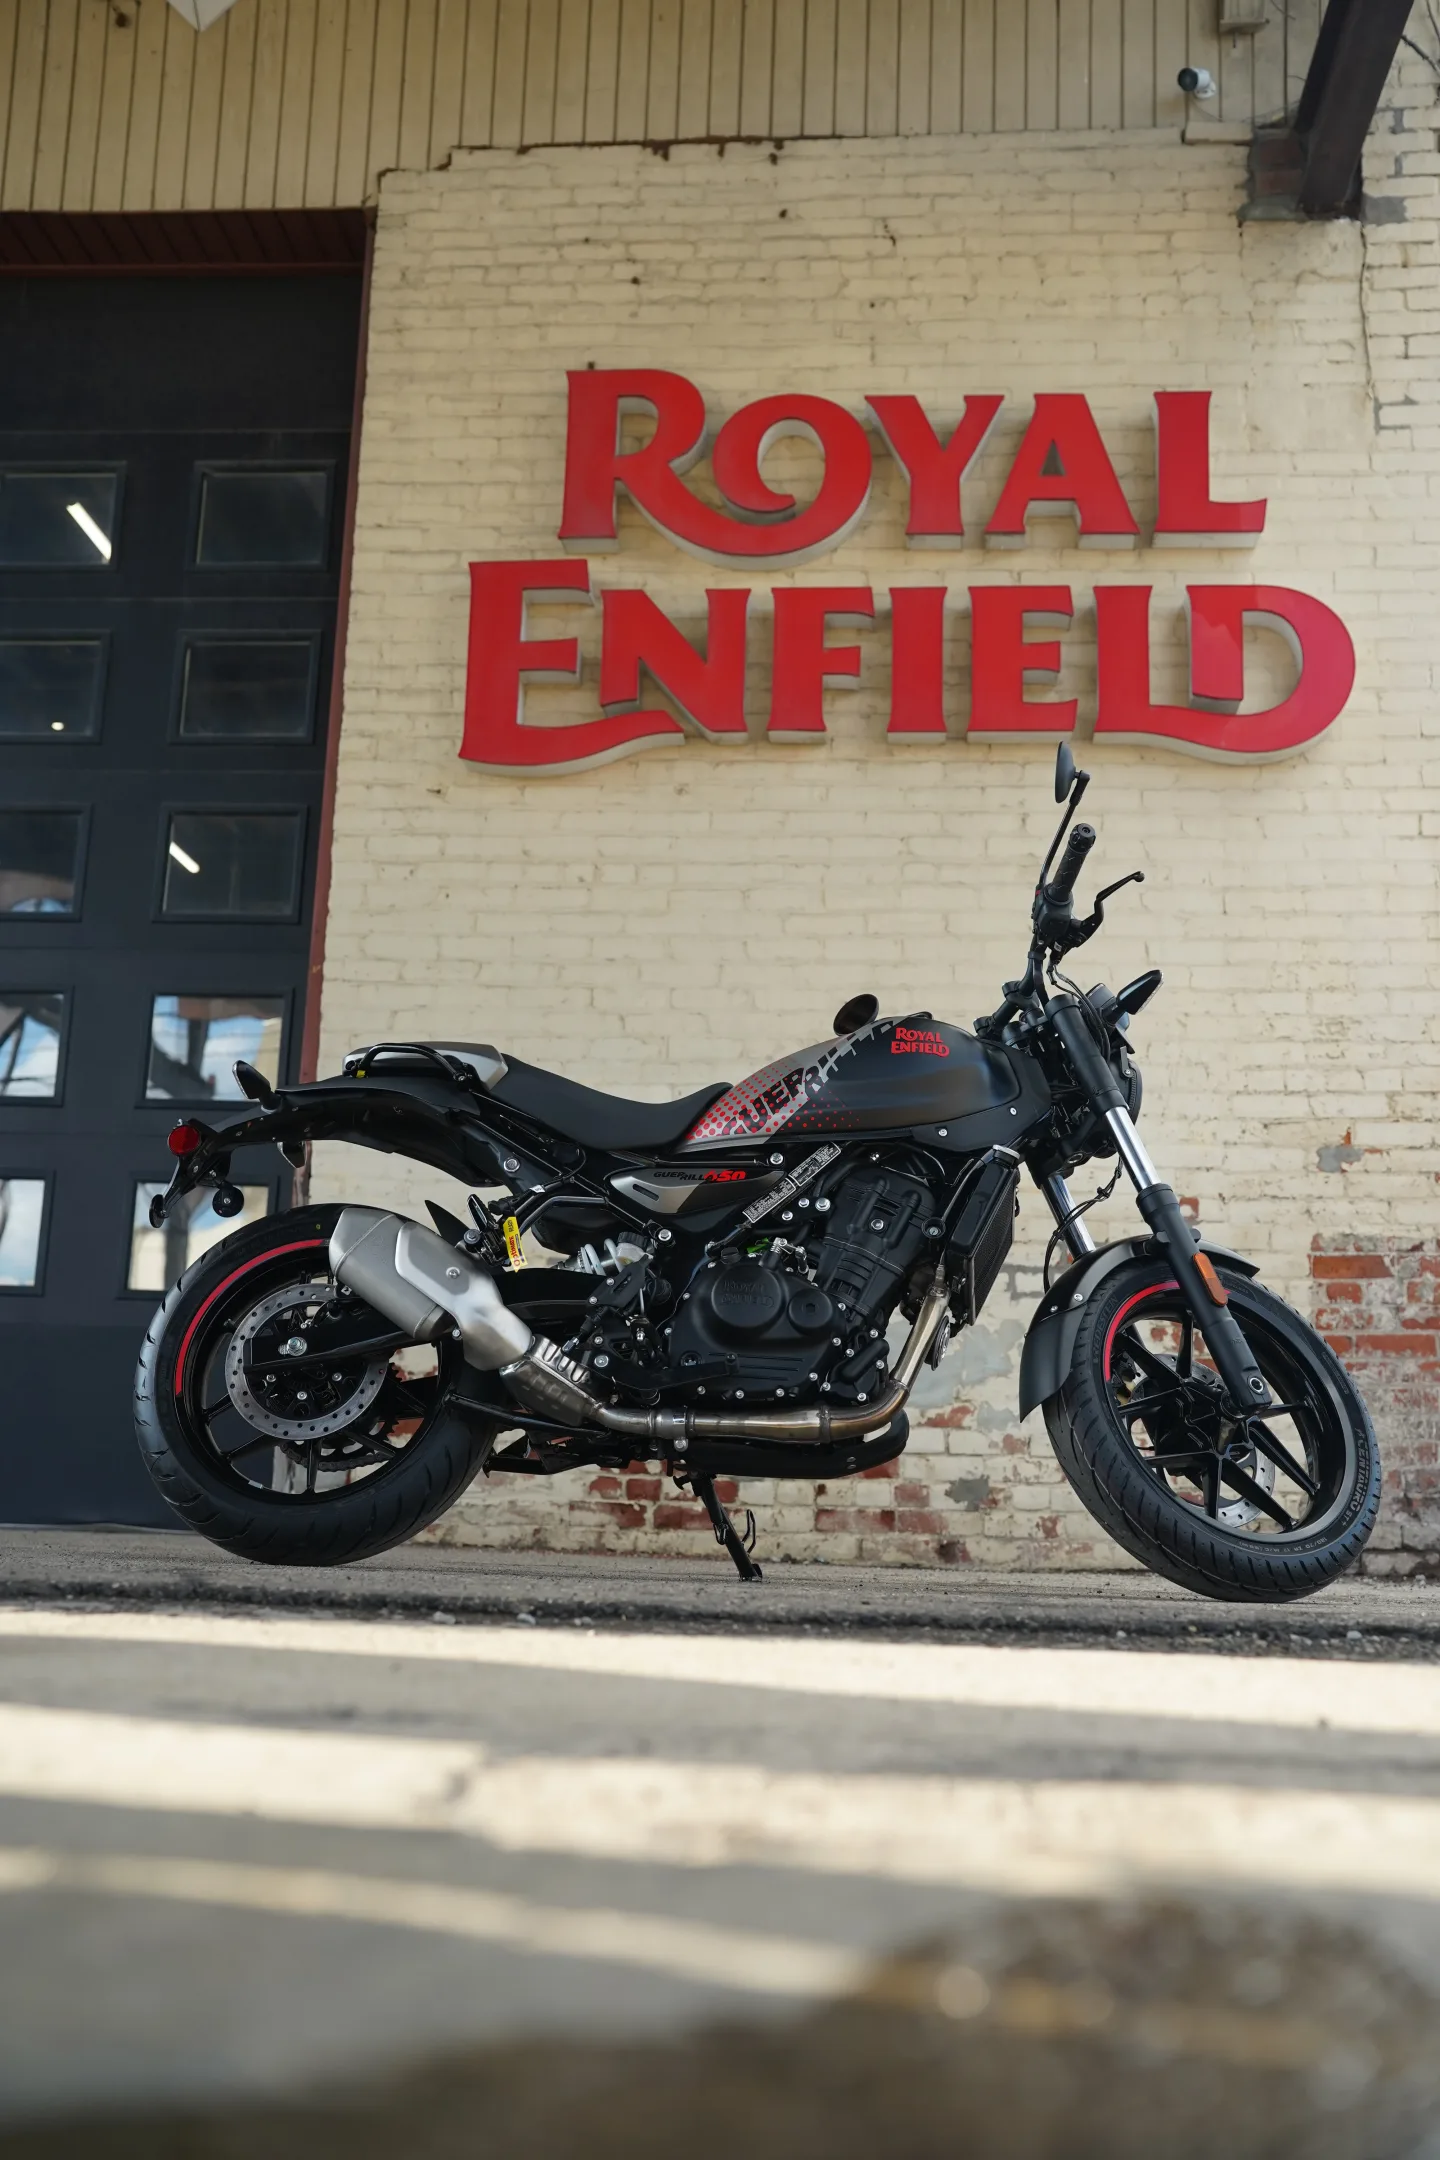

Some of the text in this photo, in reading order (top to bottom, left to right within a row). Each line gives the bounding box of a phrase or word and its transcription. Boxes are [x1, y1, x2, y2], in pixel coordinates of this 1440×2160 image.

[558, 368, 1268, 568] ROYAL
[458, 559, 1356, 774] ENFIELD
[891, 1041, 950, 1057] ENFIELD
[895, 1027, 943, 1042] ROYAL
[704, 1169, 746, 1182] 450
[1350, 1439, 1370, 1512] CENTAURO
